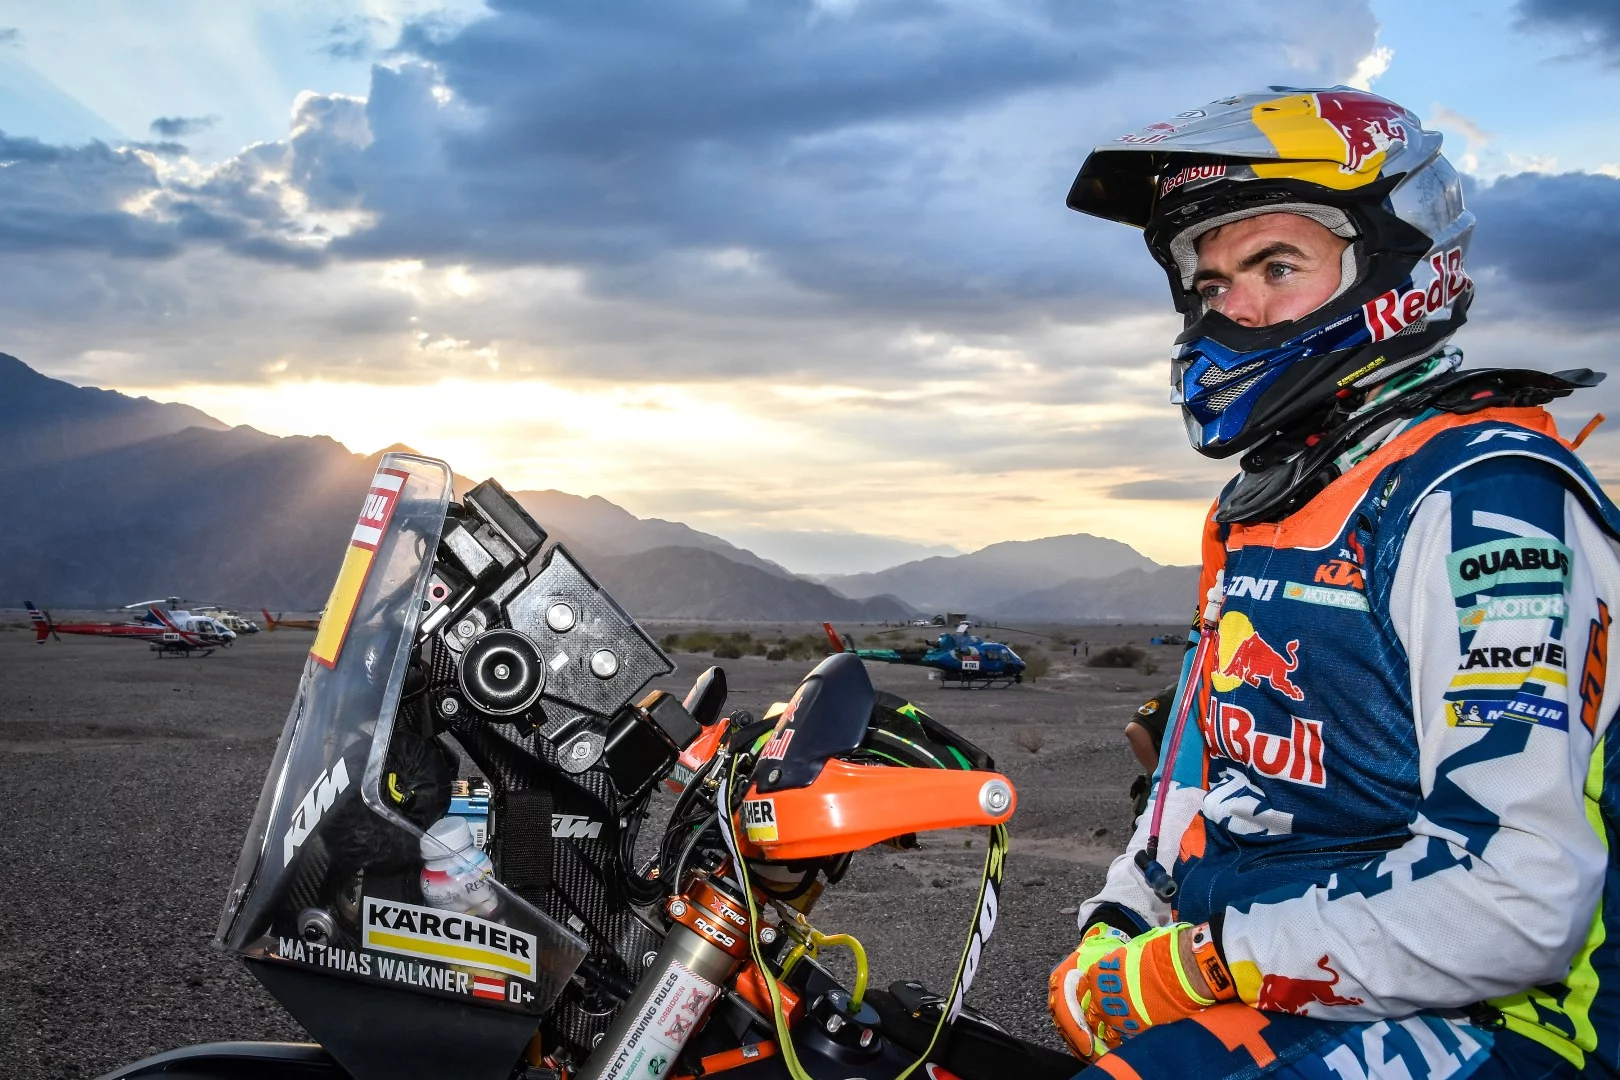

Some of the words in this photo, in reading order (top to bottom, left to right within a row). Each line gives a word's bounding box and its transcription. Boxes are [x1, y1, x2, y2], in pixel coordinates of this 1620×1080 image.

[1160, 168, 1187, 199] Red
[1186, 164, 1226, 181] Bull
[1362, 251, 1445, 343] Red
[360, 494, 389, 521] TUL
[1226, 576, 1279, 601] INI
[1487, 596, 1565, 617] MOTOR
[1220, 702, 1326, 789] Bull
[284, 757, 350, 868] KTM
[711, 895, 747, 926] XTRIG
[368, 904, 531, 959] KÄRCHER
[694, 917, 736, 947] ROCS
[279, 936, 371, 975] MATTHIAS
[377, 957, 469, 994] WALKNER
[657, 985, 686, 1026] FORBIDDEN
[605, 1047, 631, 1080] AFETY
[629, 1008, 657, 1049] DRIVING
[655, 972, 679, 1006] RULES
[621, 1046, 647, 1080] LIGATORY
